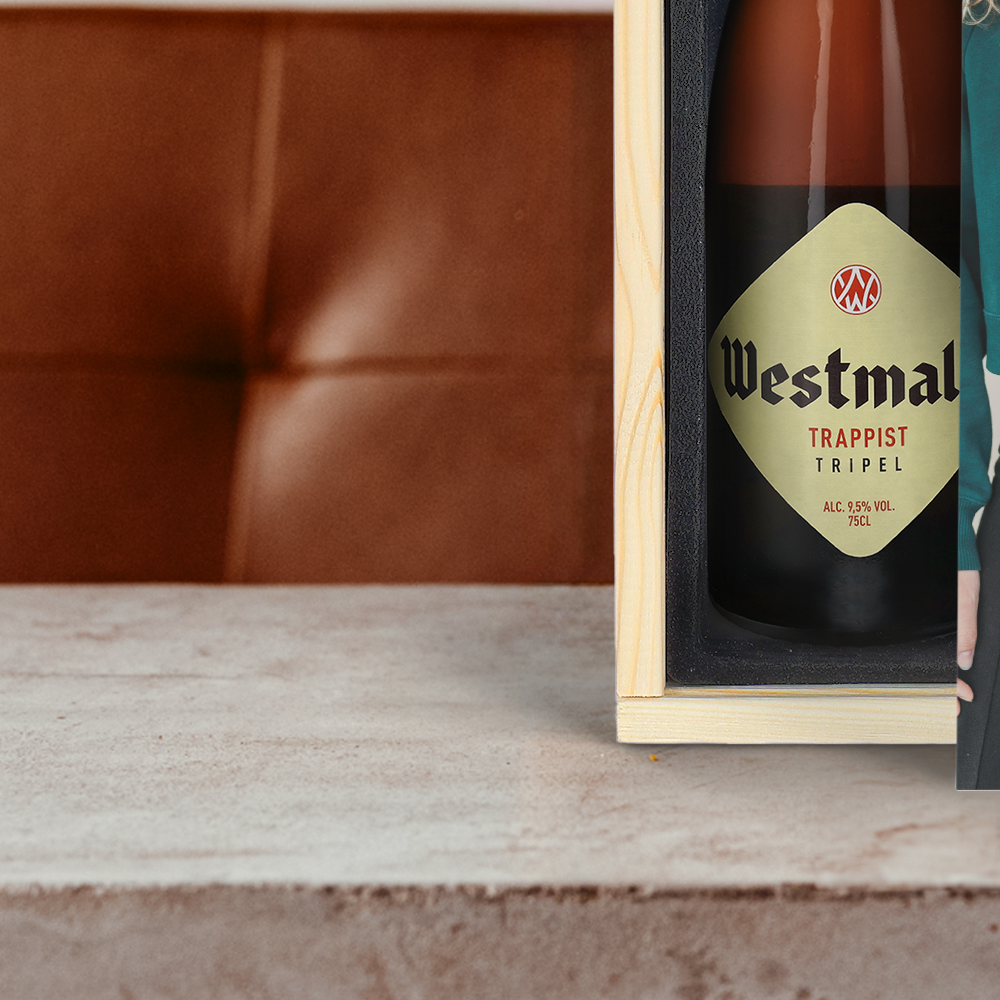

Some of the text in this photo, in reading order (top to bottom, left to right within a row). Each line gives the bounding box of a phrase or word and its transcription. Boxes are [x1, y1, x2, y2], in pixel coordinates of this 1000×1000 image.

[720, 335, 960, 410] Westmal
[808, 426, 908, 448] TRAPPIST
[815, 456, 902, 473] TRIPEL
[823, 500, 896, 514] ALC. 9,5% VOL.
[848, 515, 871, 527] 75CL
